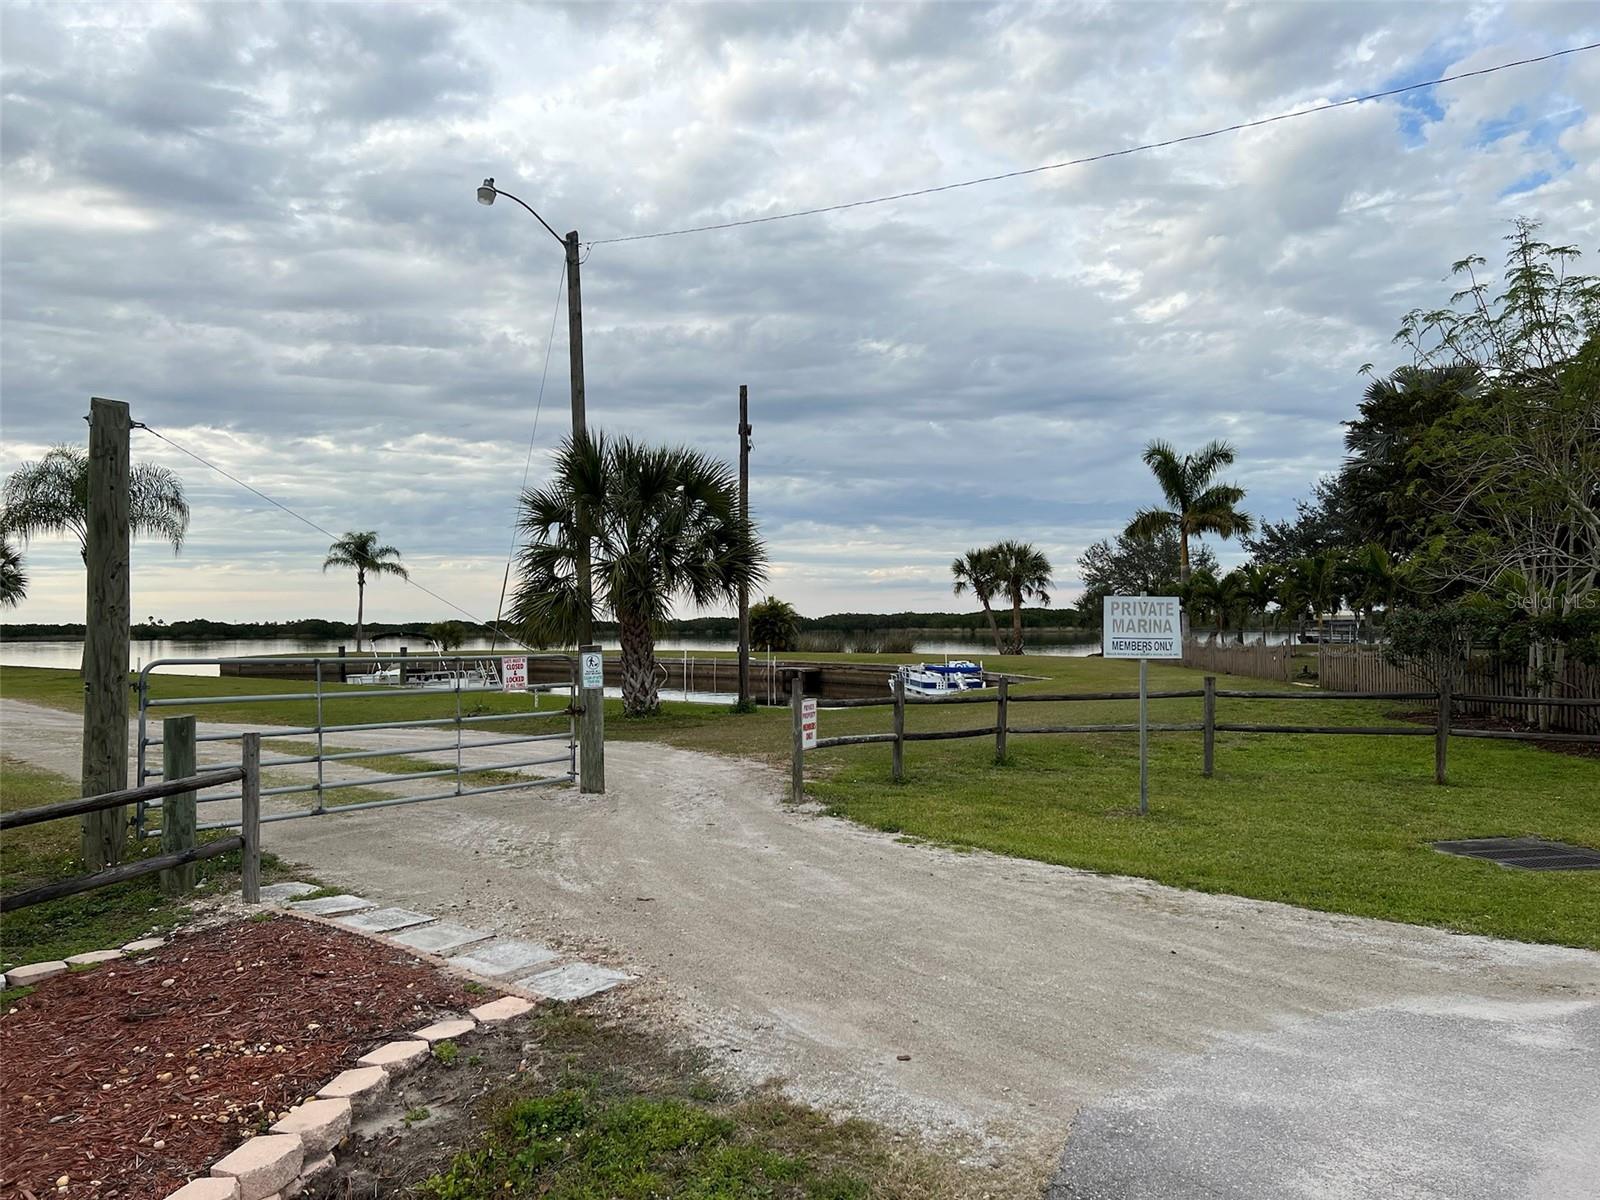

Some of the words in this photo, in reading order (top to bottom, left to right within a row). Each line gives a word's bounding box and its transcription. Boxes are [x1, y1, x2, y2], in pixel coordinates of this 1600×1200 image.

[1110, 601, 1174, 617] PRIVATE
[1112, 618, 1173, 634] MARINA
[1111, 640, 1152, 651] MEMBERS
[1153, 640, 1174, 651] ONLY
